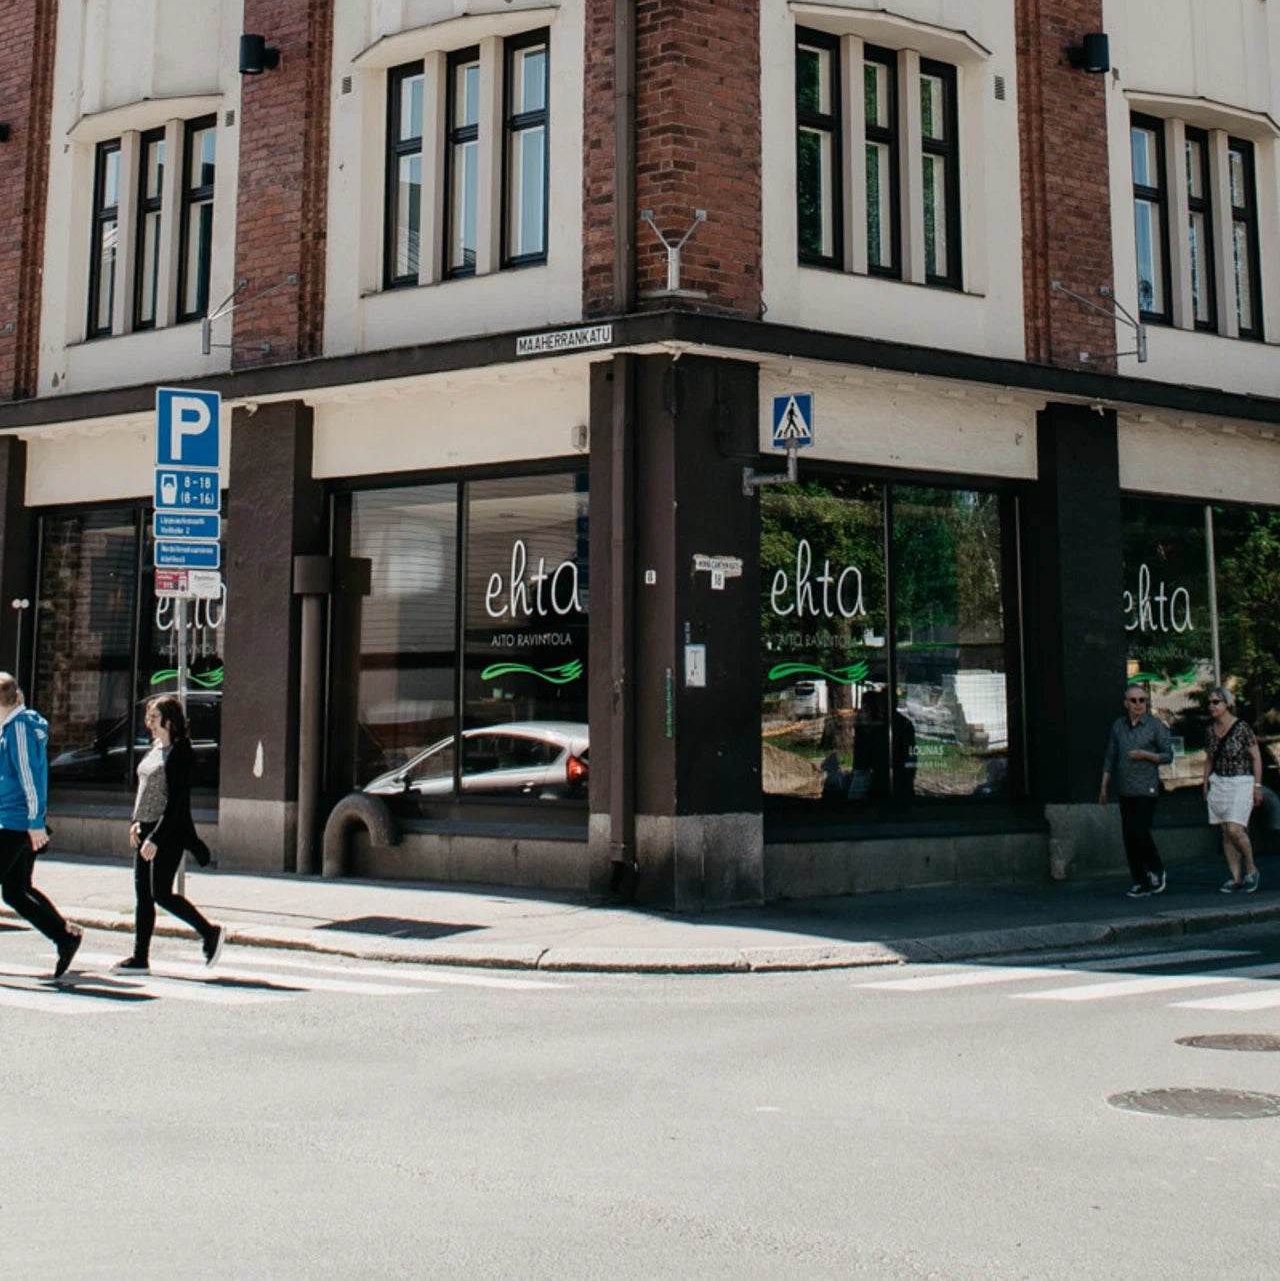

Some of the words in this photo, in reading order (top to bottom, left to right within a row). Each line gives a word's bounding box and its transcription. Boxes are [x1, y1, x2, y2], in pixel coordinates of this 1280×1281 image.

[518, 326, 611, 351] MAAHERRANKATU
[170, 396, 211, 460] P
[485, 539, 582, 617] ehta
[771, 538, 867, 618] ehta
[1123, 563, 1194, 633] ehta
[491, 634, 515, 647] AITO
[518, 632, 572, 646] RAVINTOLA
